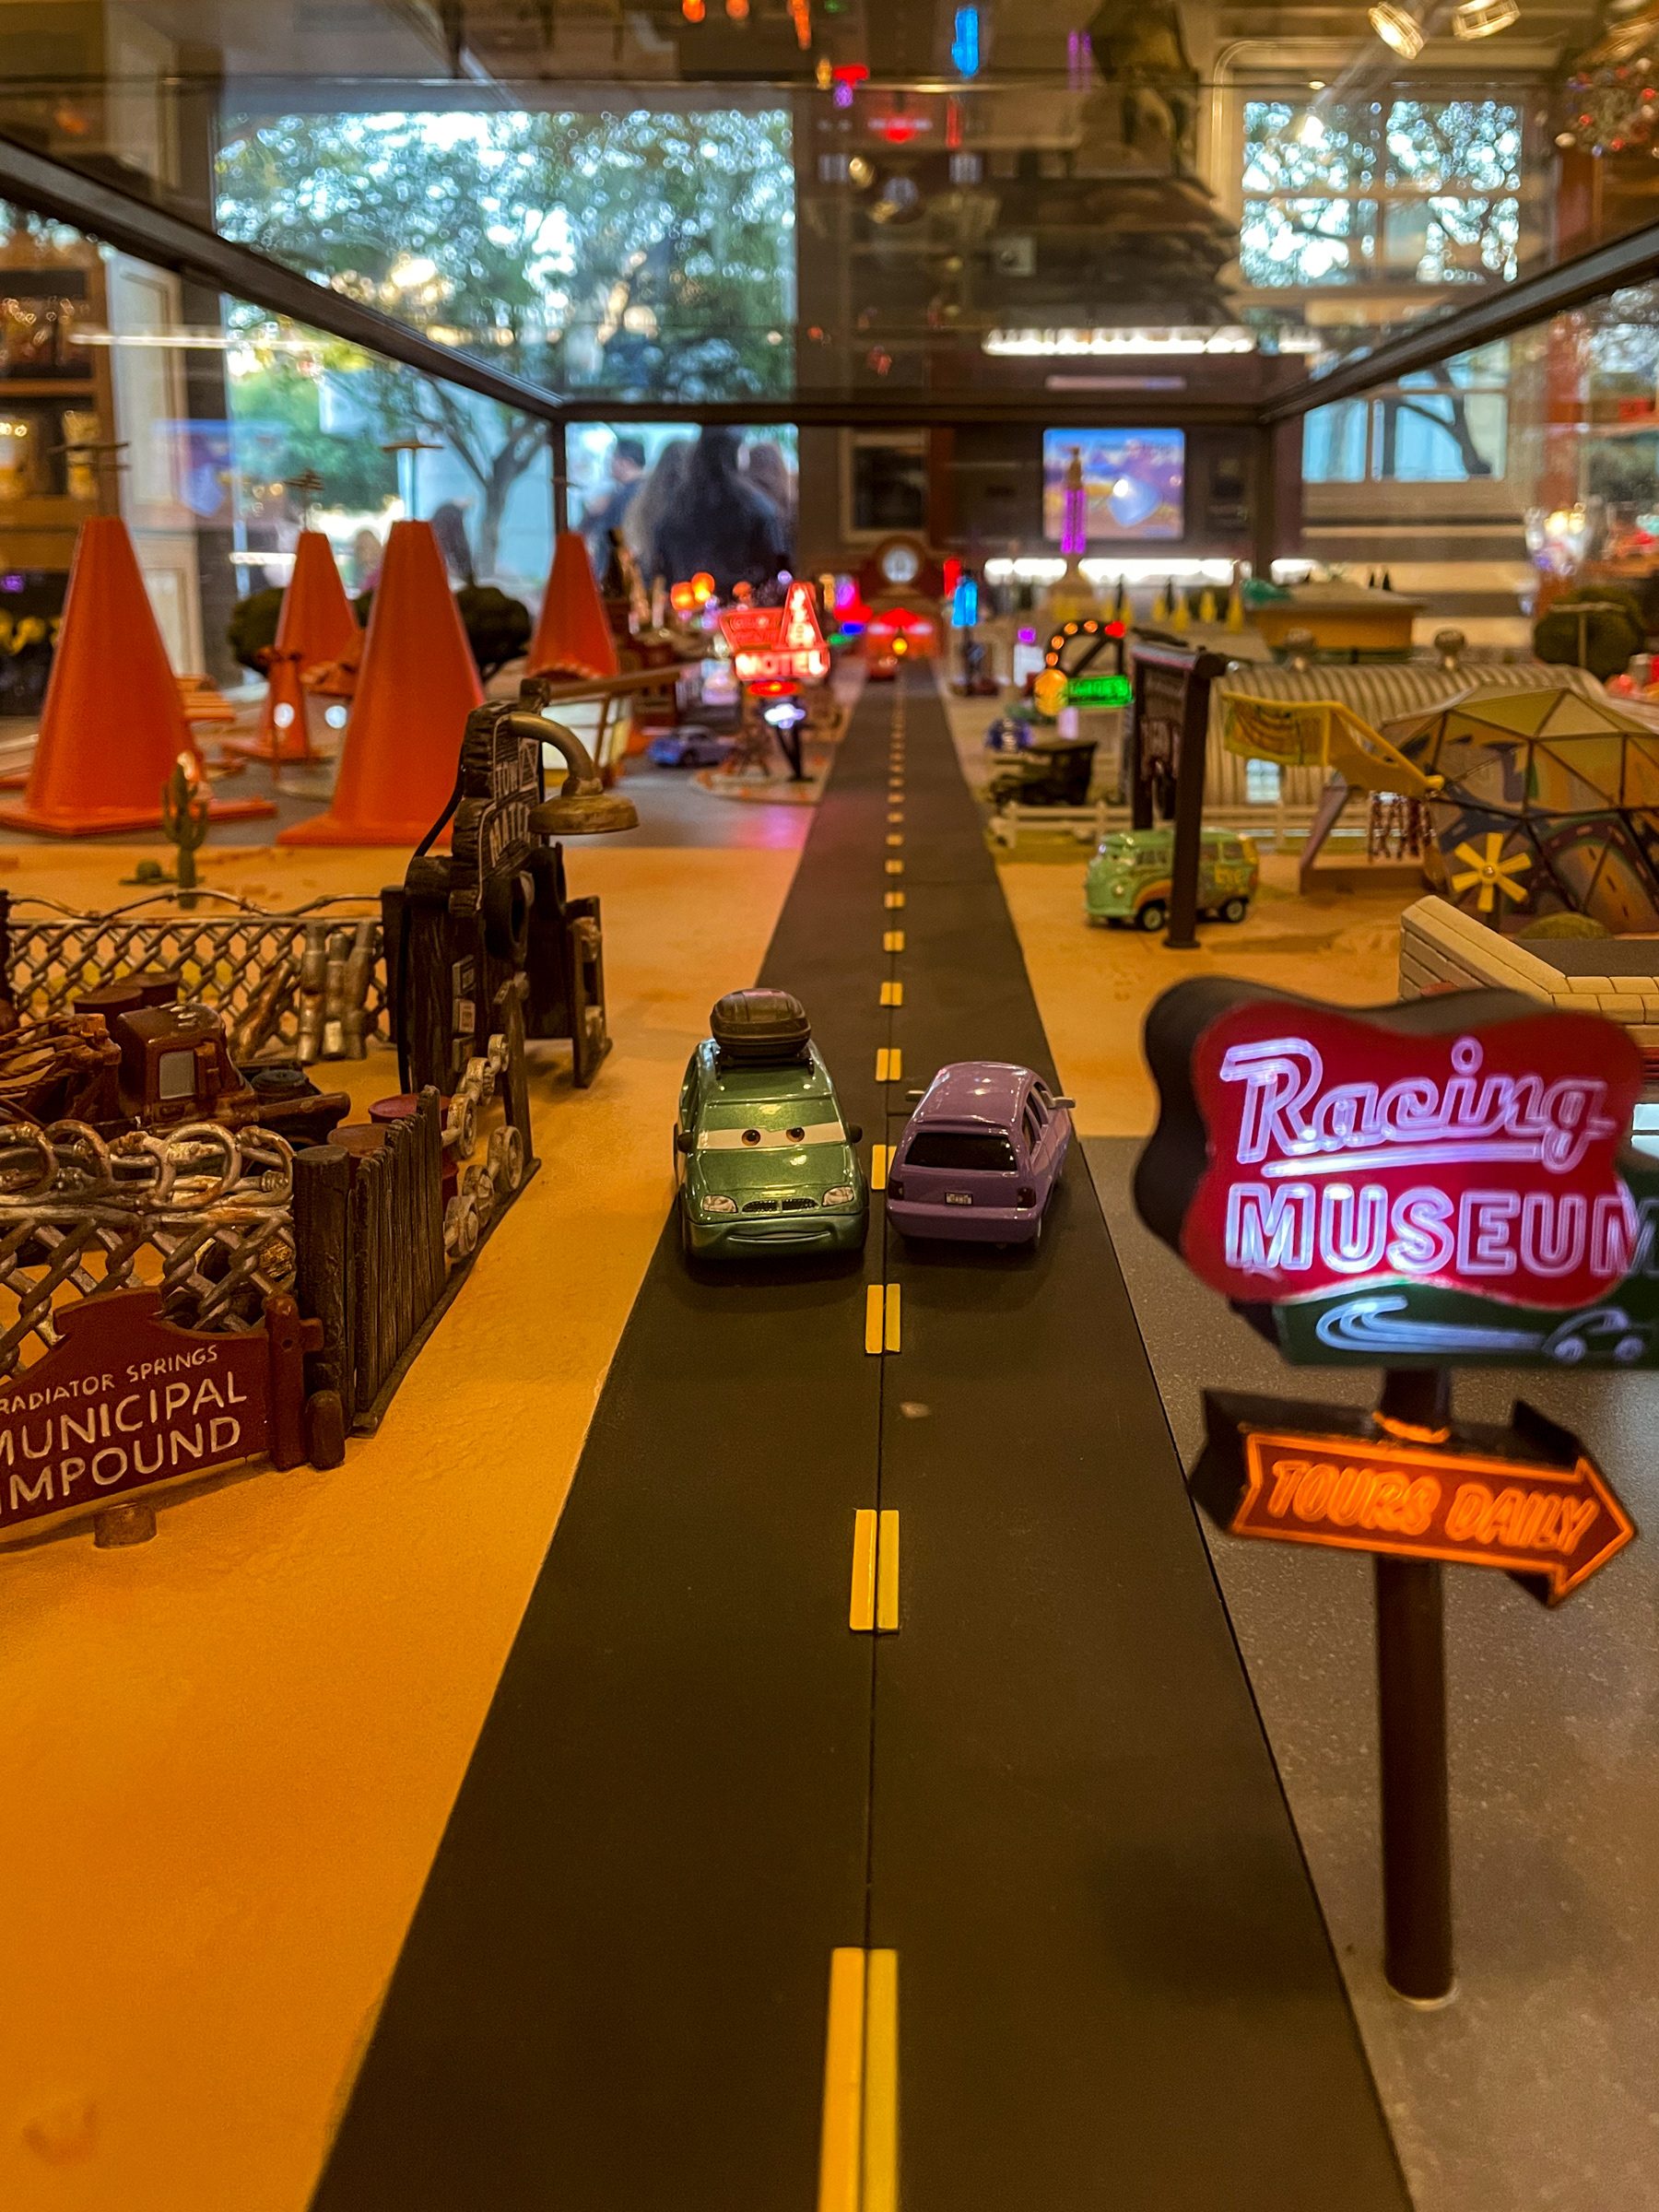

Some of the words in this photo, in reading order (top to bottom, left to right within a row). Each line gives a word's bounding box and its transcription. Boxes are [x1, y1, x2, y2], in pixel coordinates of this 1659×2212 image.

[735, 651, 828, 676] MOTEL
[1220, 1036, 1617, 1173] Racing
[1225, 1182, 1659, 1279] MUSEUM
[0, 1373, 115, 1415] RADIATOR
[125, 1344, 218, 1382] SPRINGS
[0, 1416, 241, 1514] MPOUND
[1266, 1460, 1442, 1536] TOURS
[1444, 1483, 1601, 1556] DAILY
